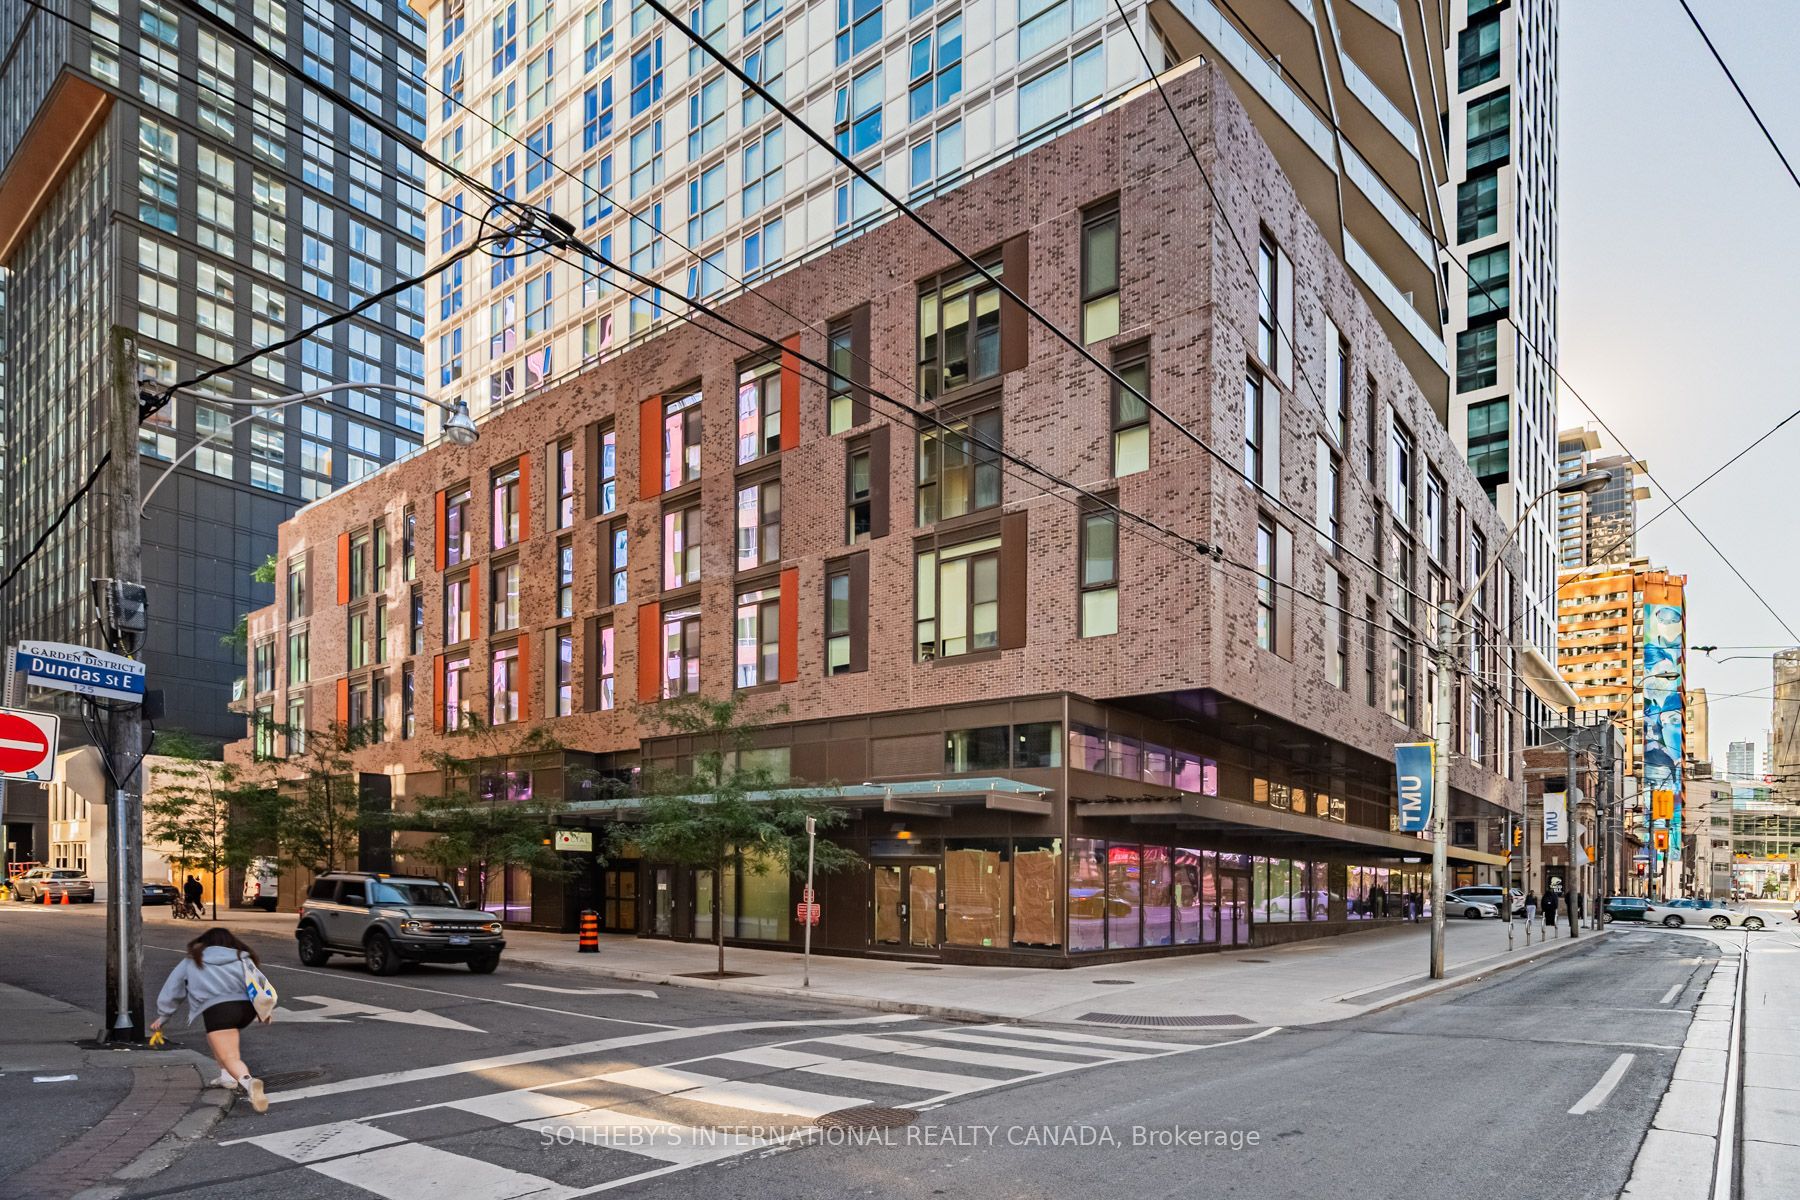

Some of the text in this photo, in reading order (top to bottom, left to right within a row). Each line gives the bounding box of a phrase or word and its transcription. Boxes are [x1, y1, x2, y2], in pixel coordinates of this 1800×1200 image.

[30, 646, 136, 673] GARDEN DISTRICT
[31, 658, 133, 689] Dundas St E
[73, 684, 95, 694] 125
[1400, 775, 1422, 826] TMU
[1545, 811, 1558, 840] TMU
